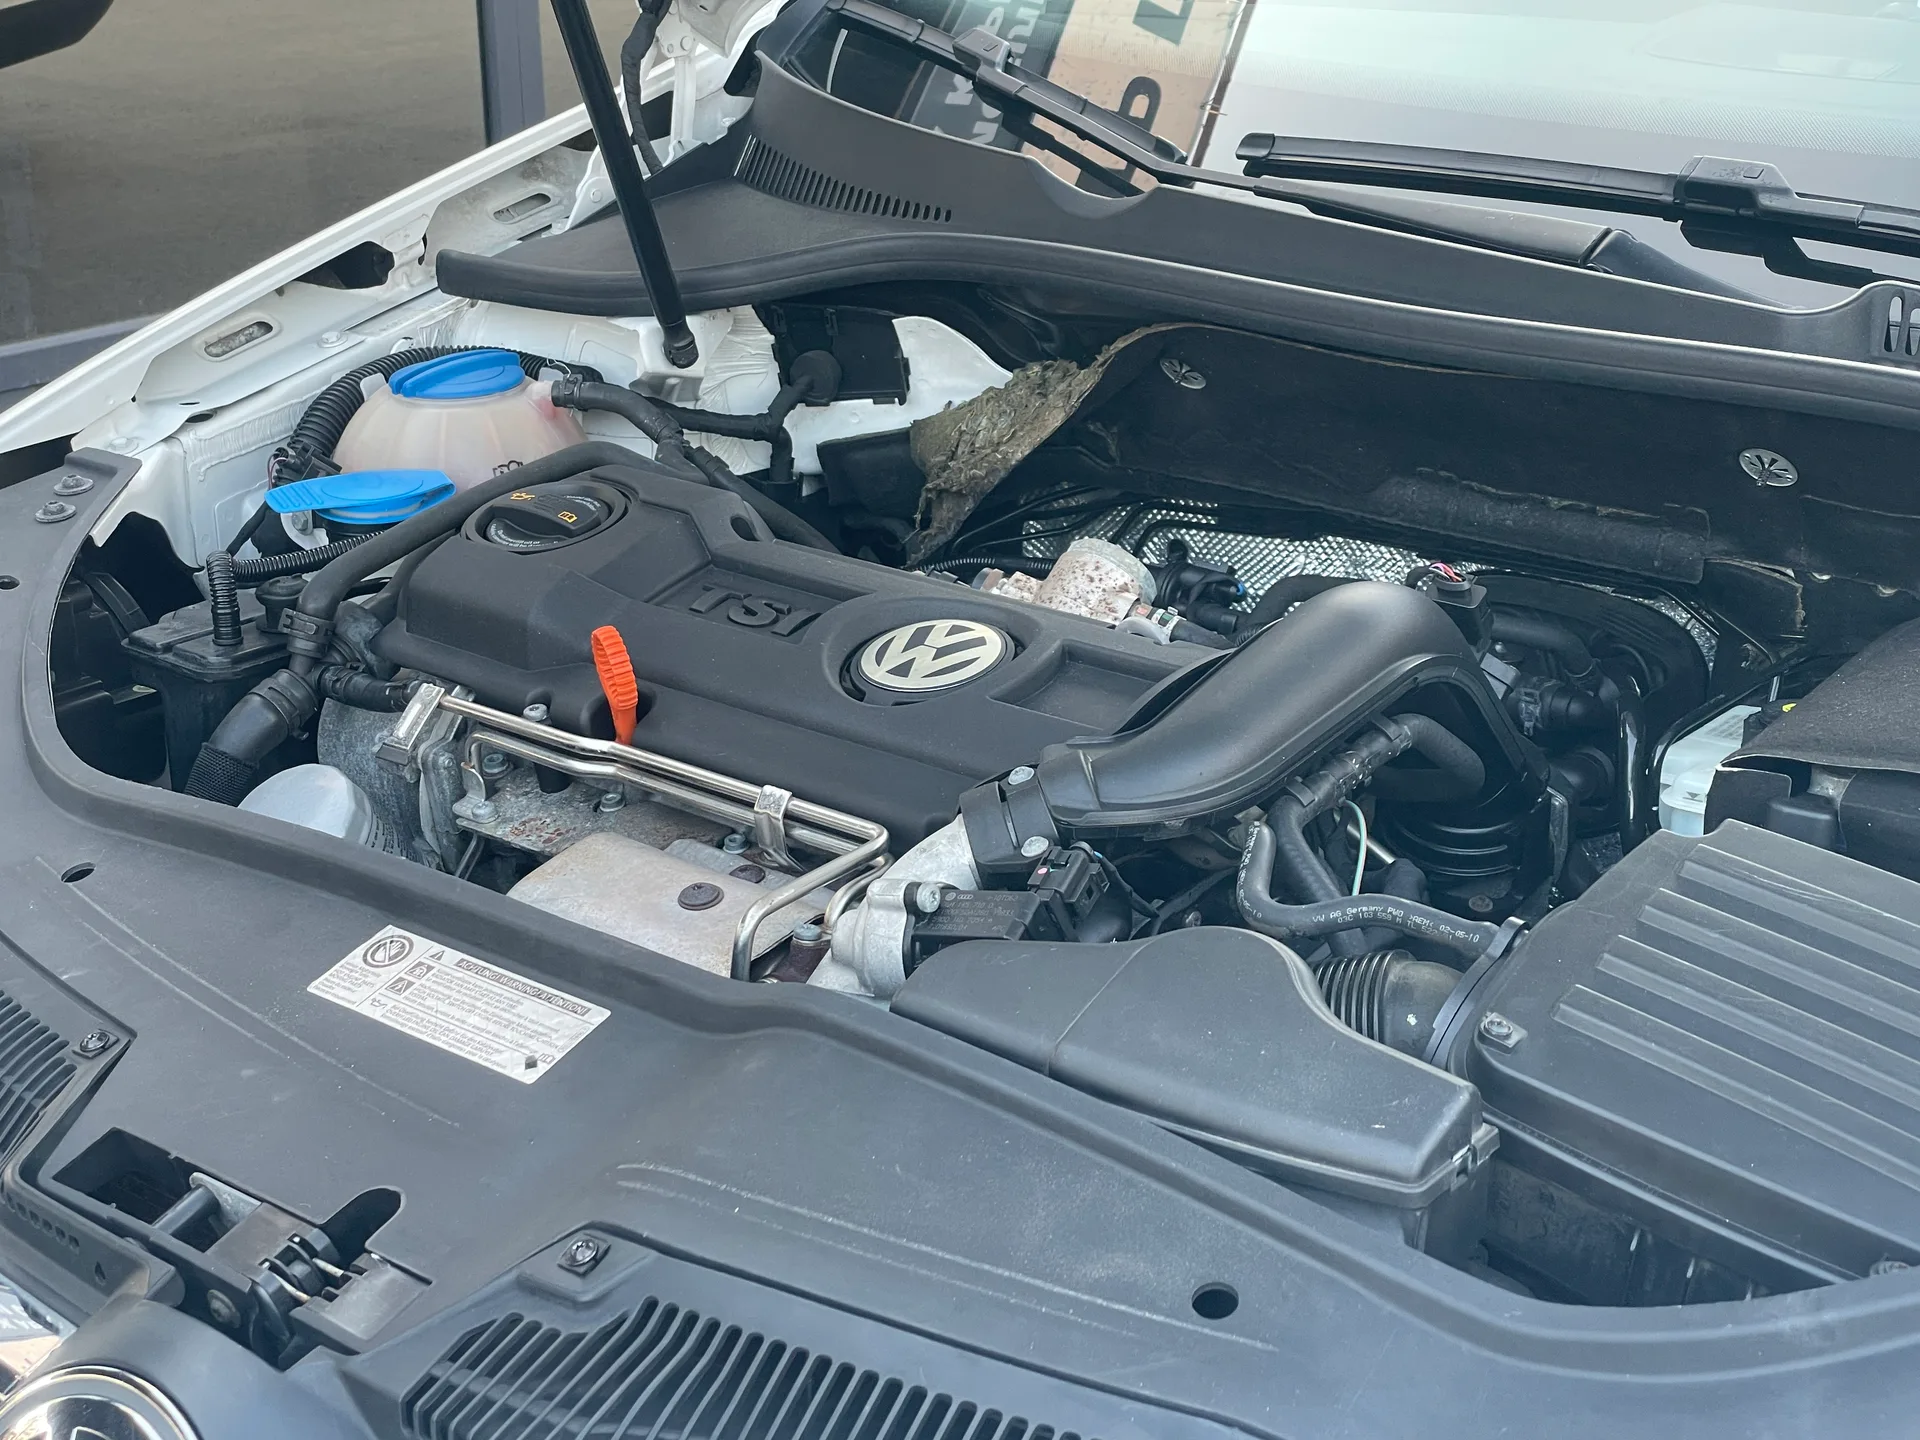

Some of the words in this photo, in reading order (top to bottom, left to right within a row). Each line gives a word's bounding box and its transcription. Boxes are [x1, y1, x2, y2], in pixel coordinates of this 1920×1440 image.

[689, 584, 822, 637] TSI
[1346, 906, 1384, 915] Germany
[459, 960, 500, 980] ACHTUNG!
[500, 976, 540, 997] WARNING!
[540, 991, 588, 1014] ATTENTION!
